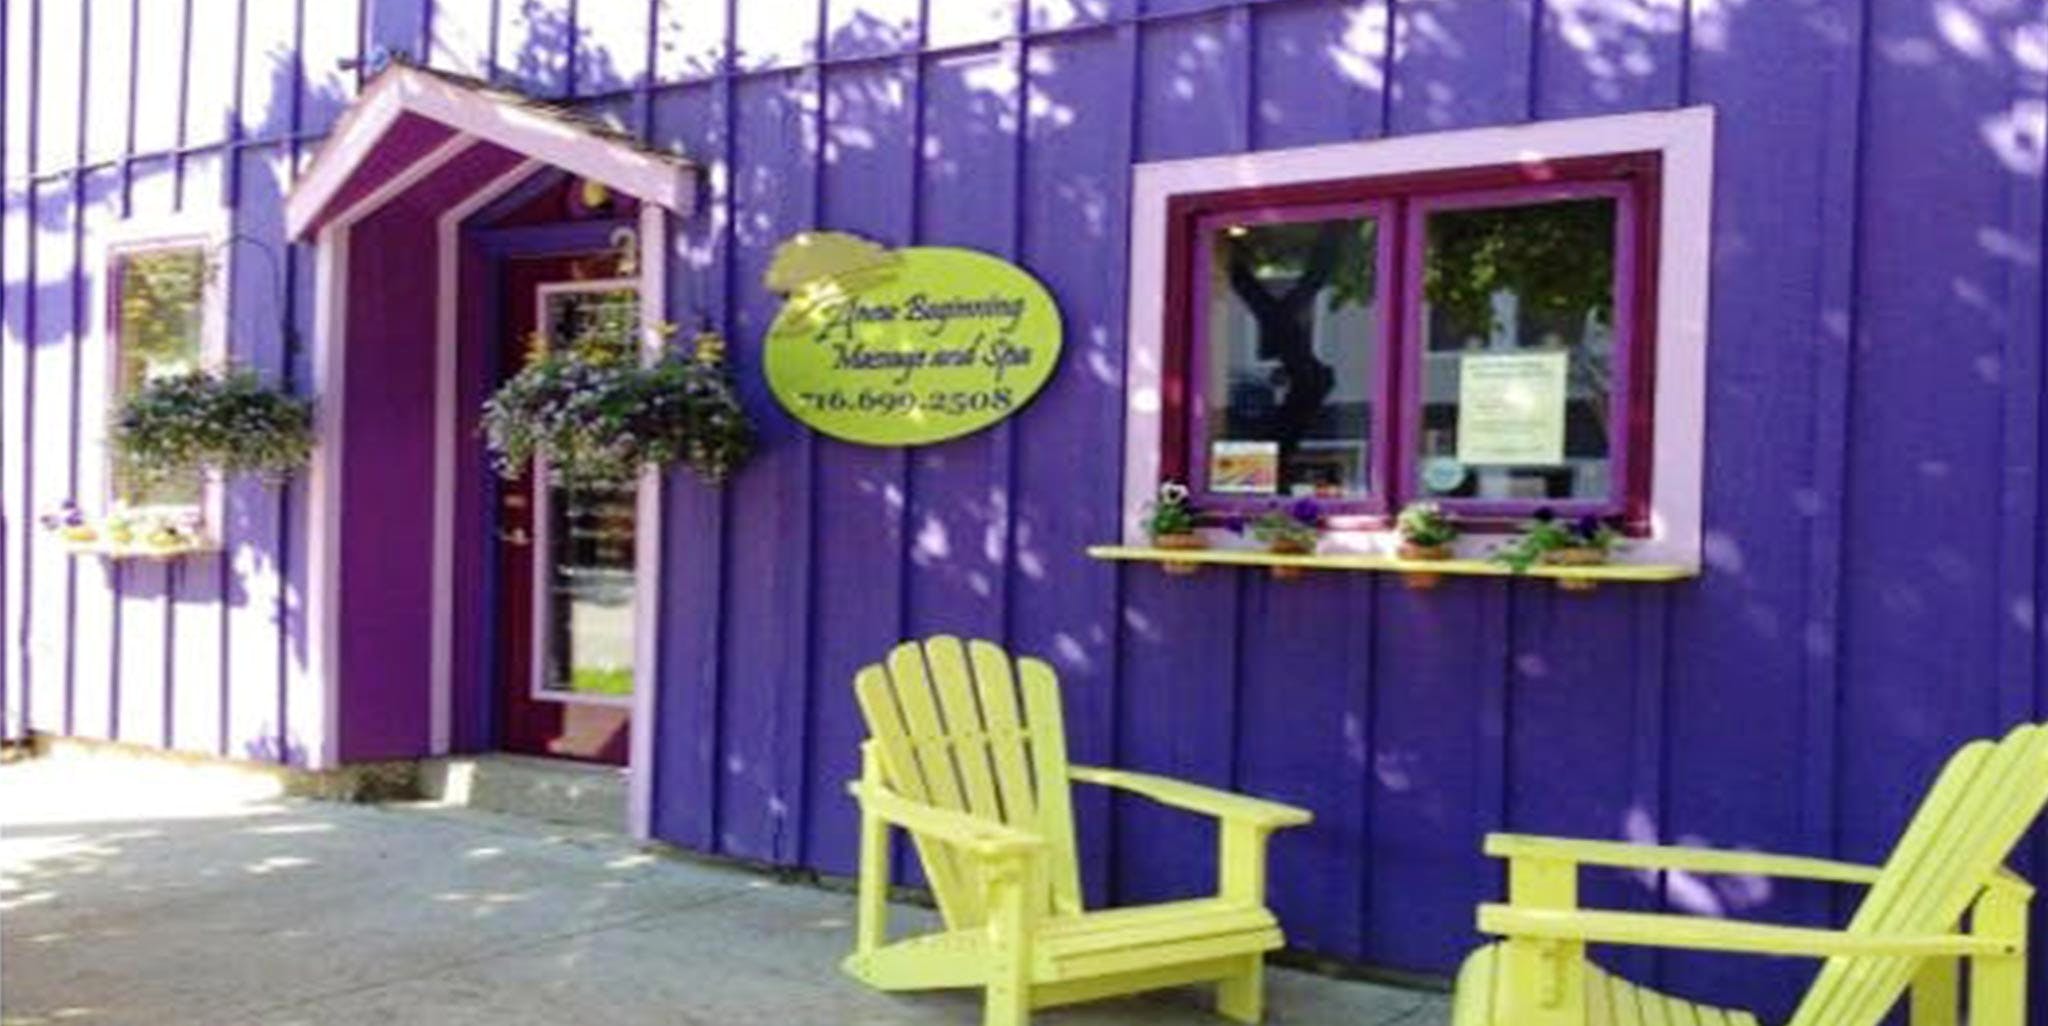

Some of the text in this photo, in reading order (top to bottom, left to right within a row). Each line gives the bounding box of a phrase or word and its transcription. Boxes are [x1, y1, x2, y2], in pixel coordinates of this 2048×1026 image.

[903, 293, 1025, 336] Beginning
[831, 331, 1032, 385] Massage and Spa
[799, 388, 1012, 414] 716.699.2508
